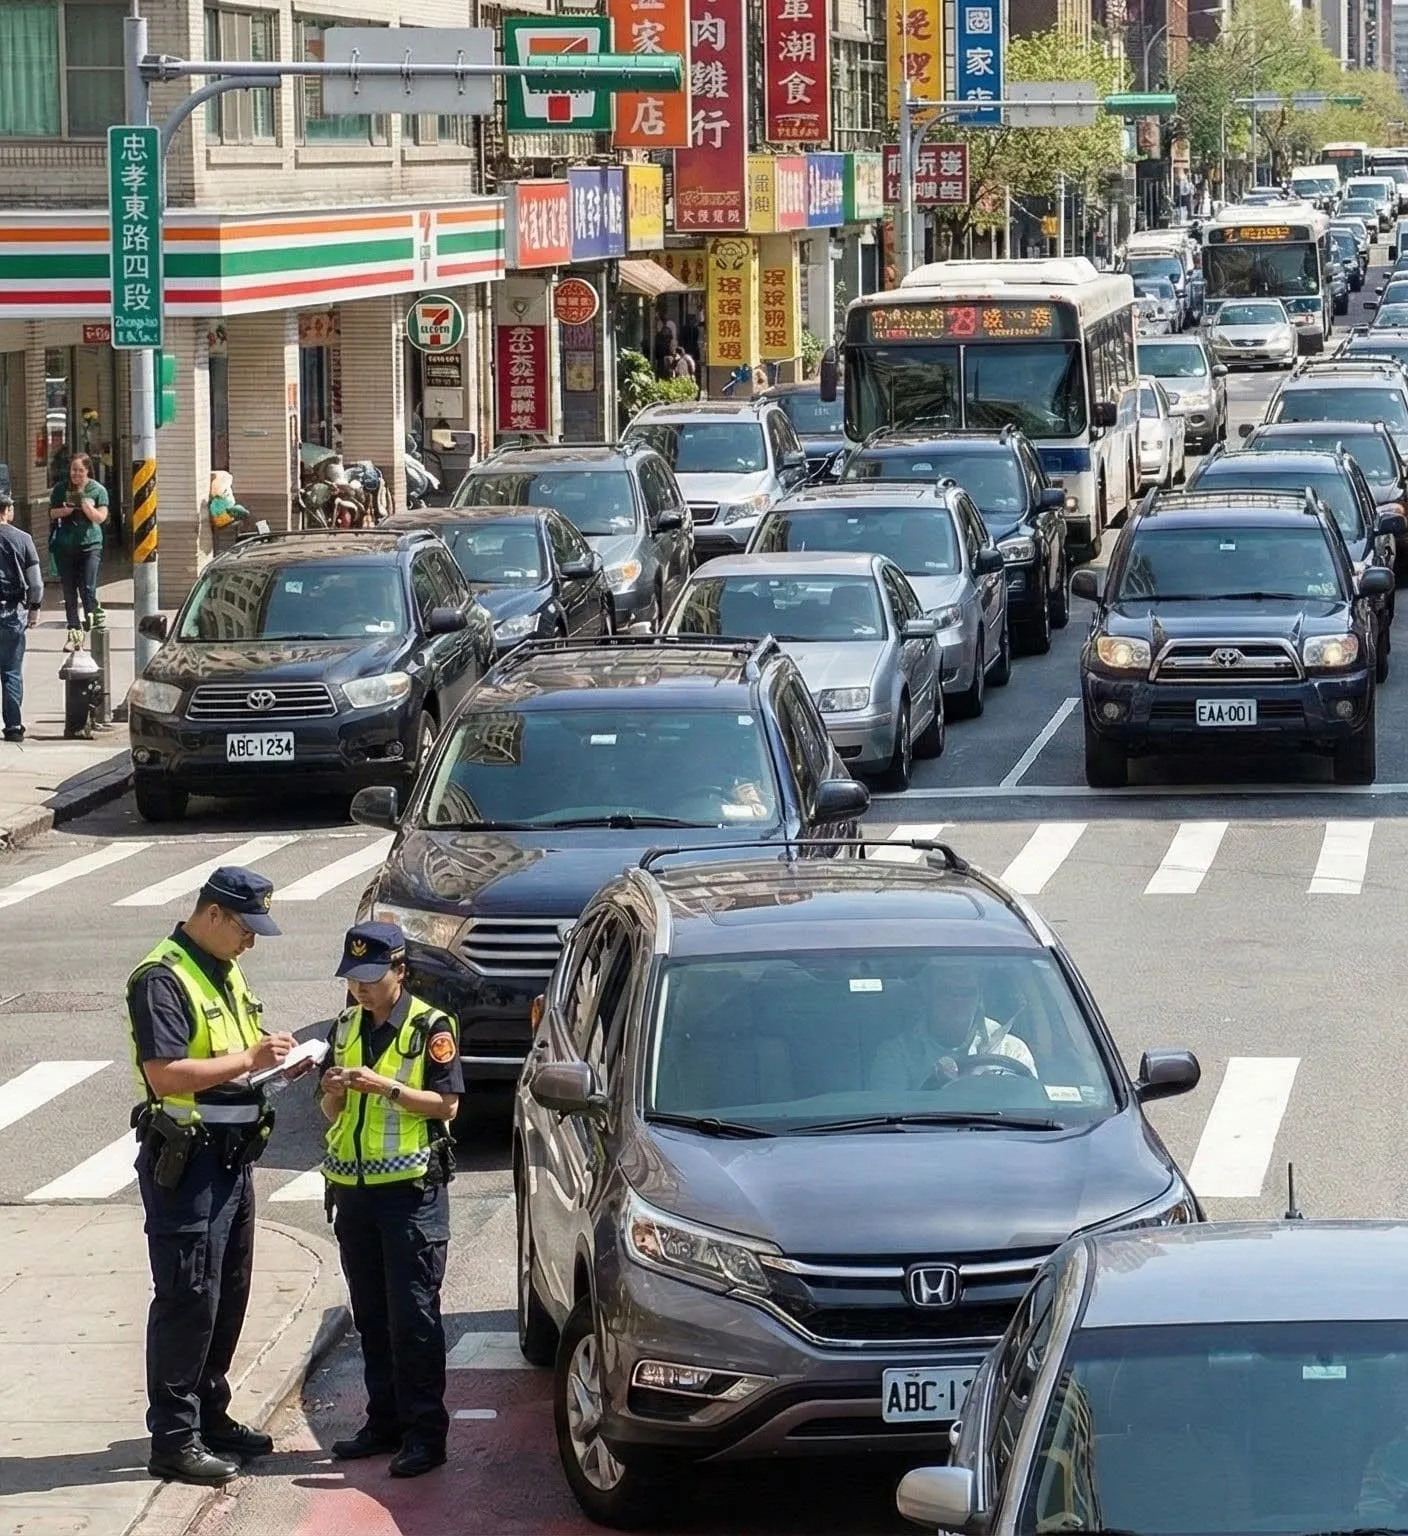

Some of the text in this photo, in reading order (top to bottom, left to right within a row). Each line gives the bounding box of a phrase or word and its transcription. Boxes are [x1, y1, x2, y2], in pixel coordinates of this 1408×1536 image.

[690, 0, 731, 148] 肉雞行
[121, 133, 151, 311] 忠孝東路四段
[1198, 704, 1252, 722] EAA-001
[228, 738, 293, 757] ABC-1234
[887, 1379, 973, 1413] ABC-1
